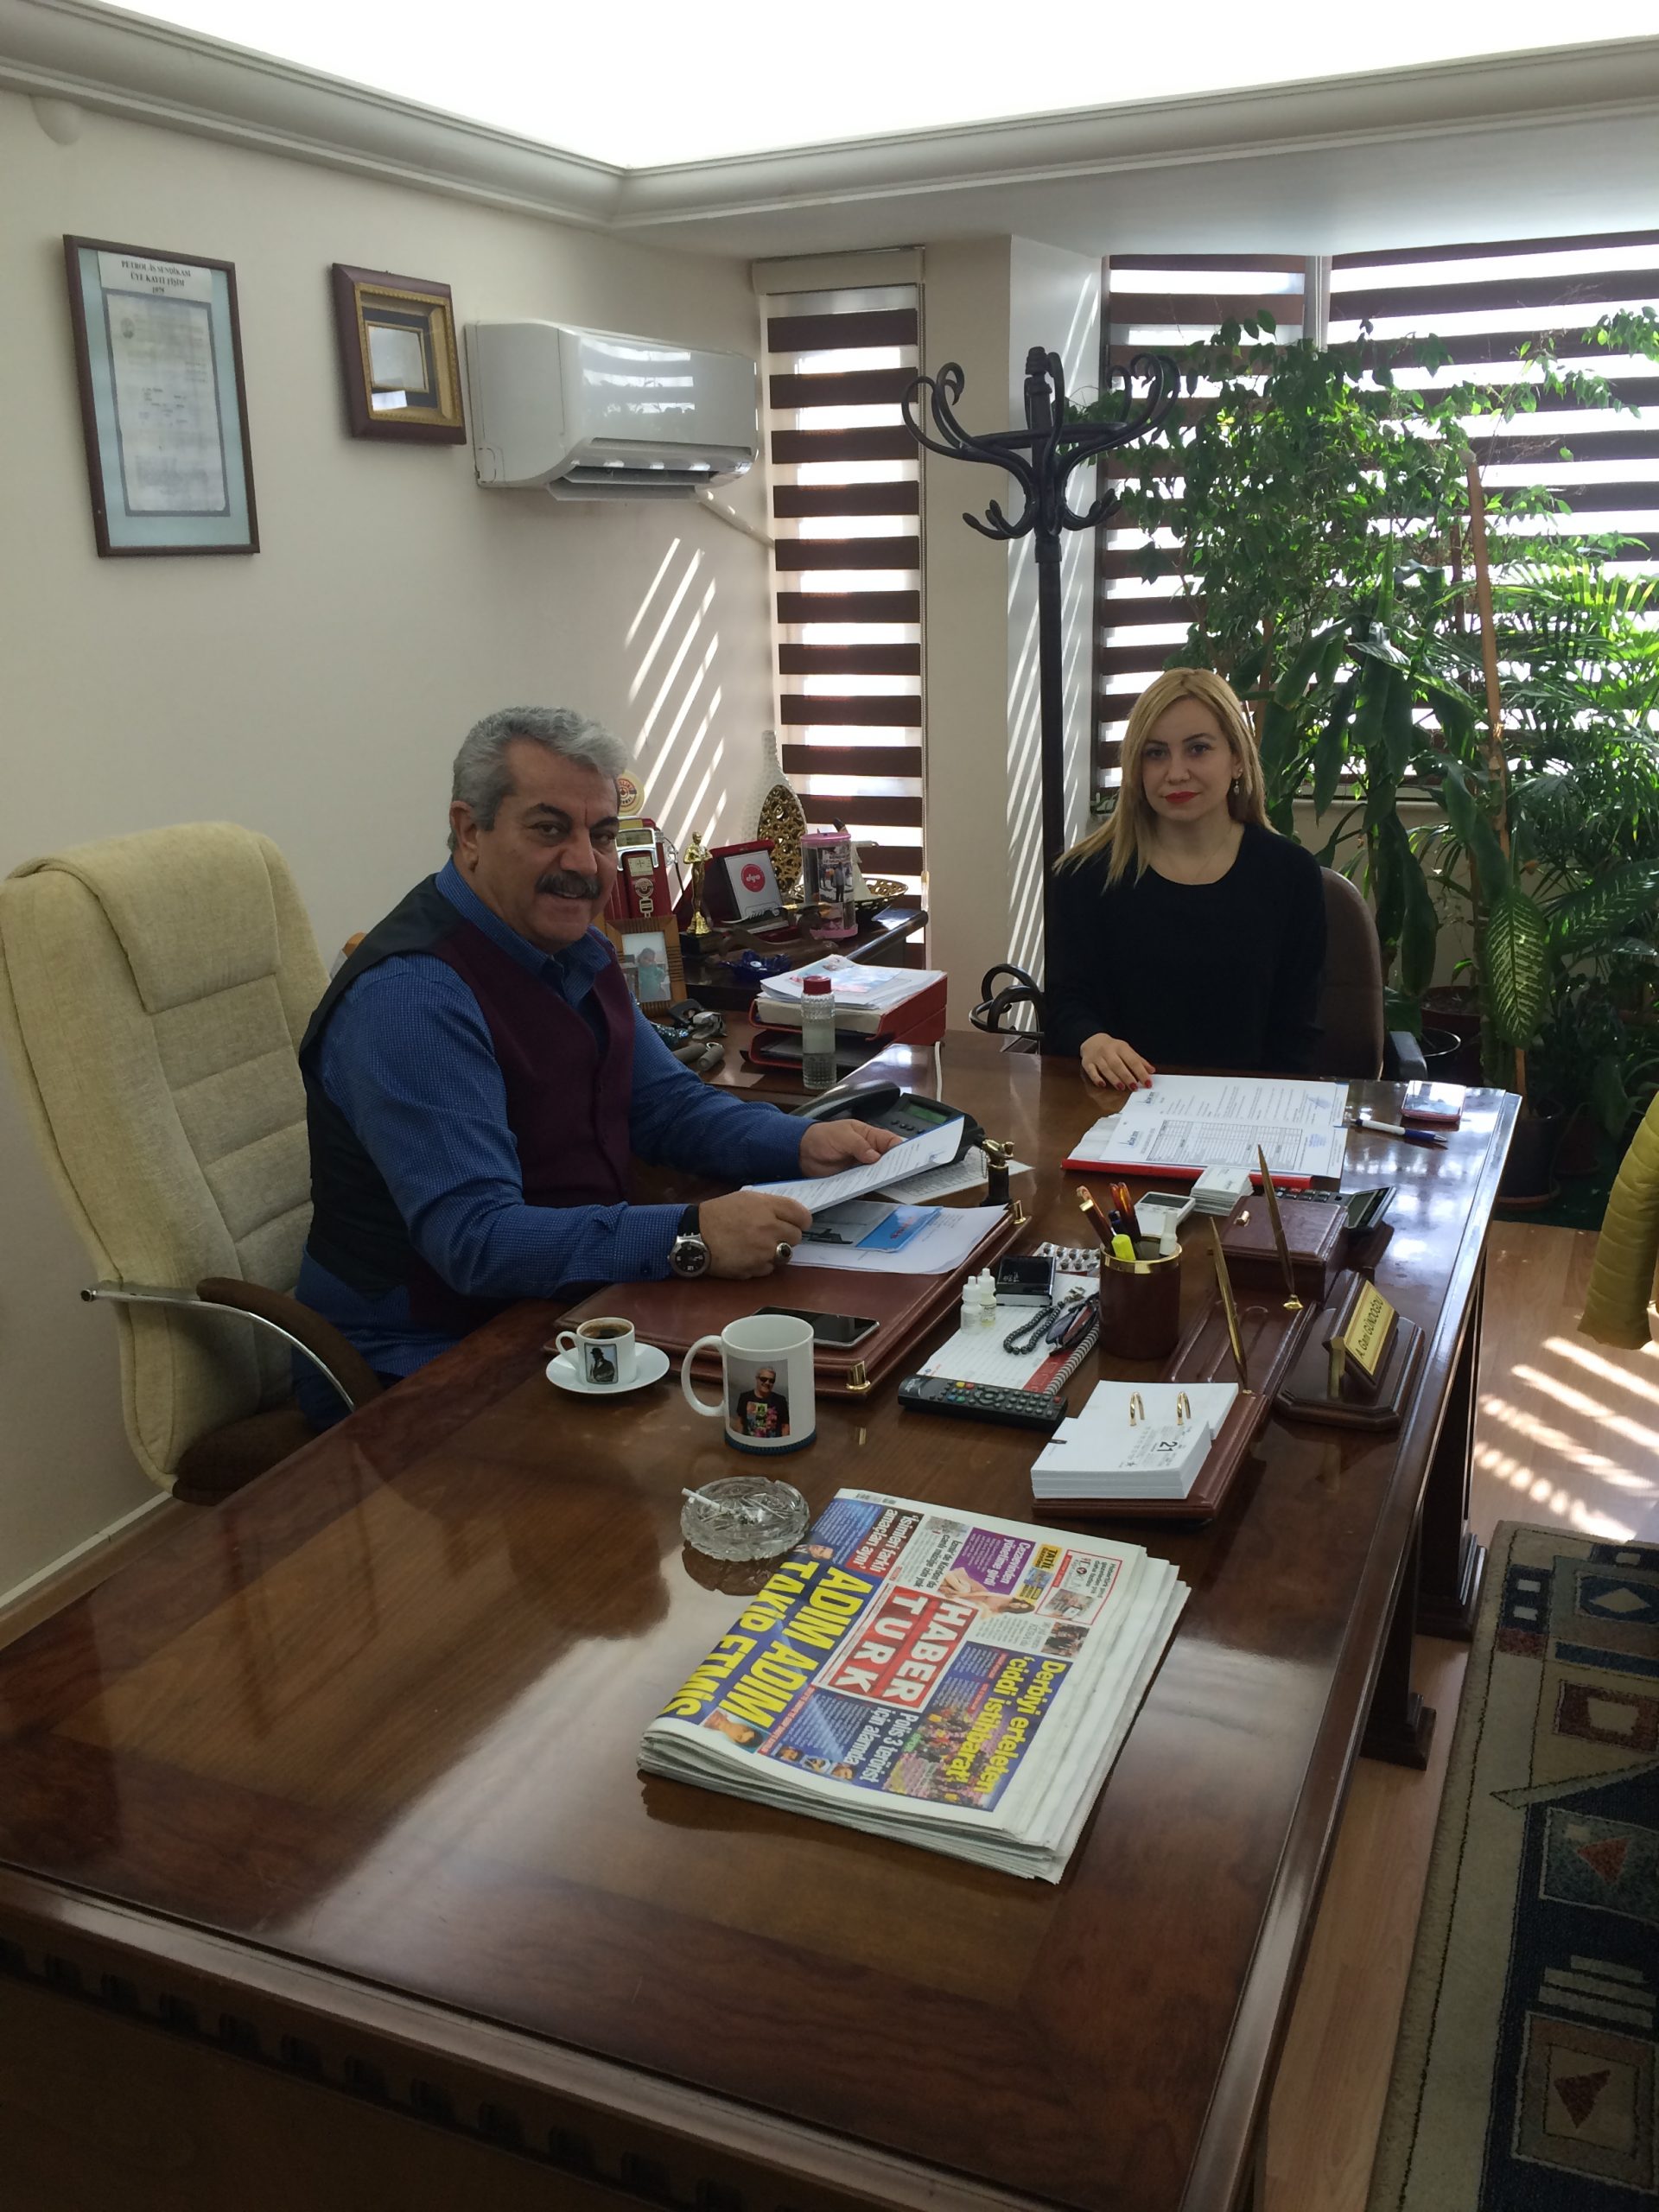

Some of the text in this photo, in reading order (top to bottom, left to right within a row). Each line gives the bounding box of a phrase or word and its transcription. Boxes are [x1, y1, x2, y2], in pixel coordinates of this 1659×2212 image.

[1156, 1441, 1179, 1452] 21
[983, 1538, 1017, 1586] yönetime girdi
[1001, 1541, 1031, 1584] Cezaevinden
[1041, 1548, 1058, 1569] TATİL
[781, 1566, 874, 1649] ADIM
[885, 1602, 973, 1702] HABER
[719, 1641, 819, 1728] ADIM
[1016, 1659, 1065, 1715] Derbiyi
[843, 1708, 887, 1764] için alarmda
[859, 1712, 917, 1783] Polis 3 terörist
[973, 1716, 1030, 1794] erteleten
